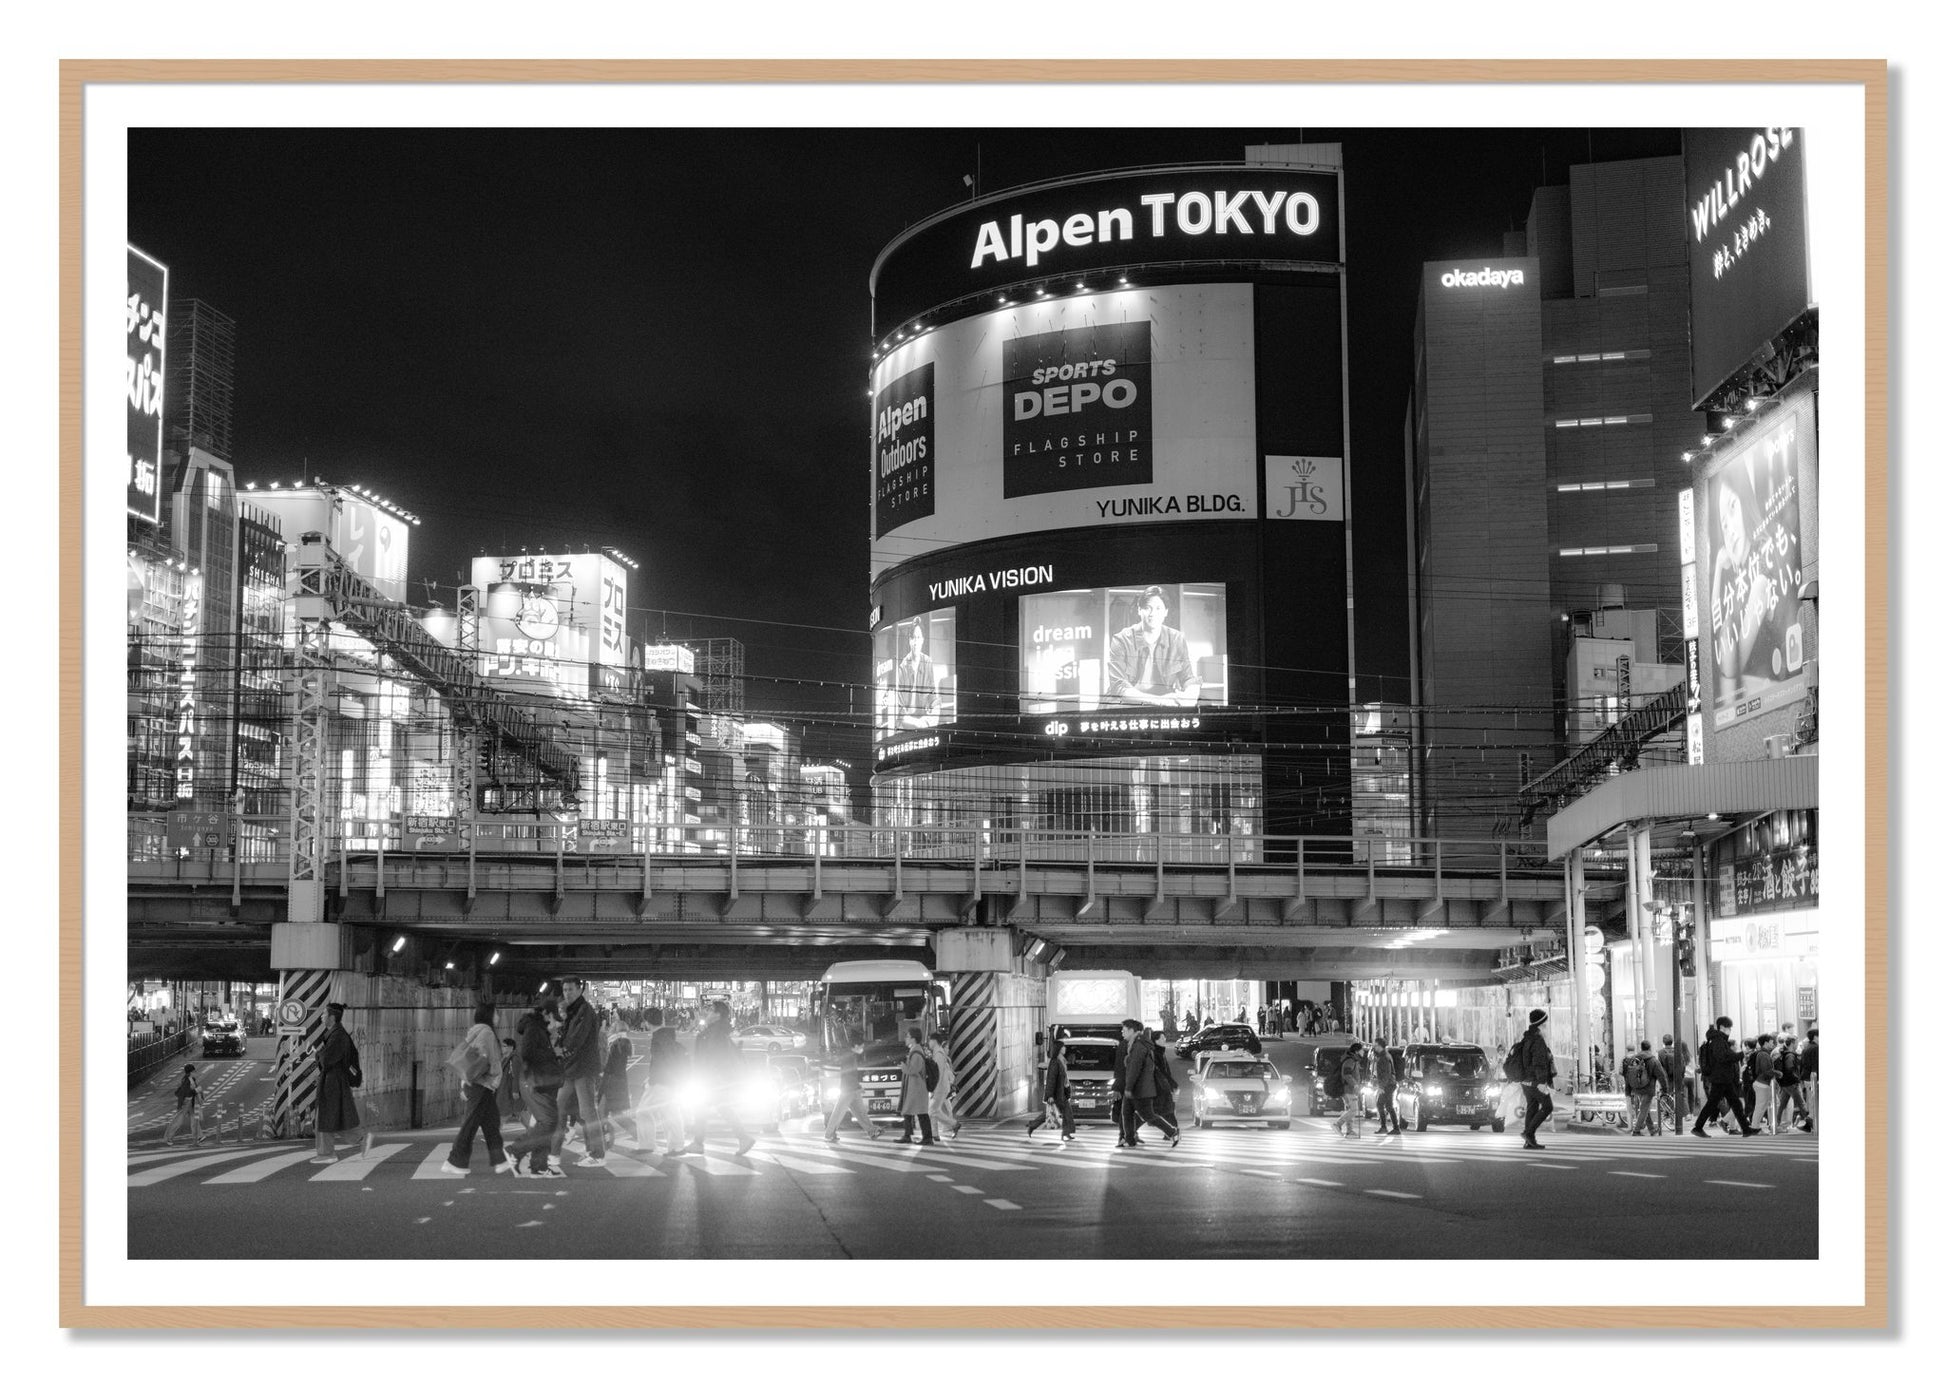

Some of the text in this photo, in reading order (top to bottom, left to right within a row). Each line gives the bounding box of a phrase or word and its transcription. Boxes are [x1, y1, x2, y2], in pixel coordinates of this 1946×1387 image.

[1691, 127, 1793, 242] WILLROSE
[970, 191, 1319, 269] Alpen TOKYO
[1441, 266, 1524, 289] okadaya
[1032, 358, 1117, 385] SPORTS
[1014, 379, 1137, 421] DEPO
[878, 395, 927, 443] Alpen
[1014, 430, 1138, 456] FLAGSHIP
[881, 435, 927, 479] Outdoors
[1058, 449, 1138, 468] STORE
[877, 465, 928, 501] FLAGSHIP
[890, 483, 928, 509] STORE
[1096, 493, 1246, 518] YUNIKA BLDG.
[249, 566, 280, 588] SHISHA
[499, 559, 574, 580] プロミス
[929, 565, 1054, 602] YUNIKA VISION
[1033, 624, 1093, 643] dream
[1045, 719, 1069, 737] dip
[406, 816, 456, 828] 新宿駅東口
[580, 819, 626, 831] 新宿駅東口
